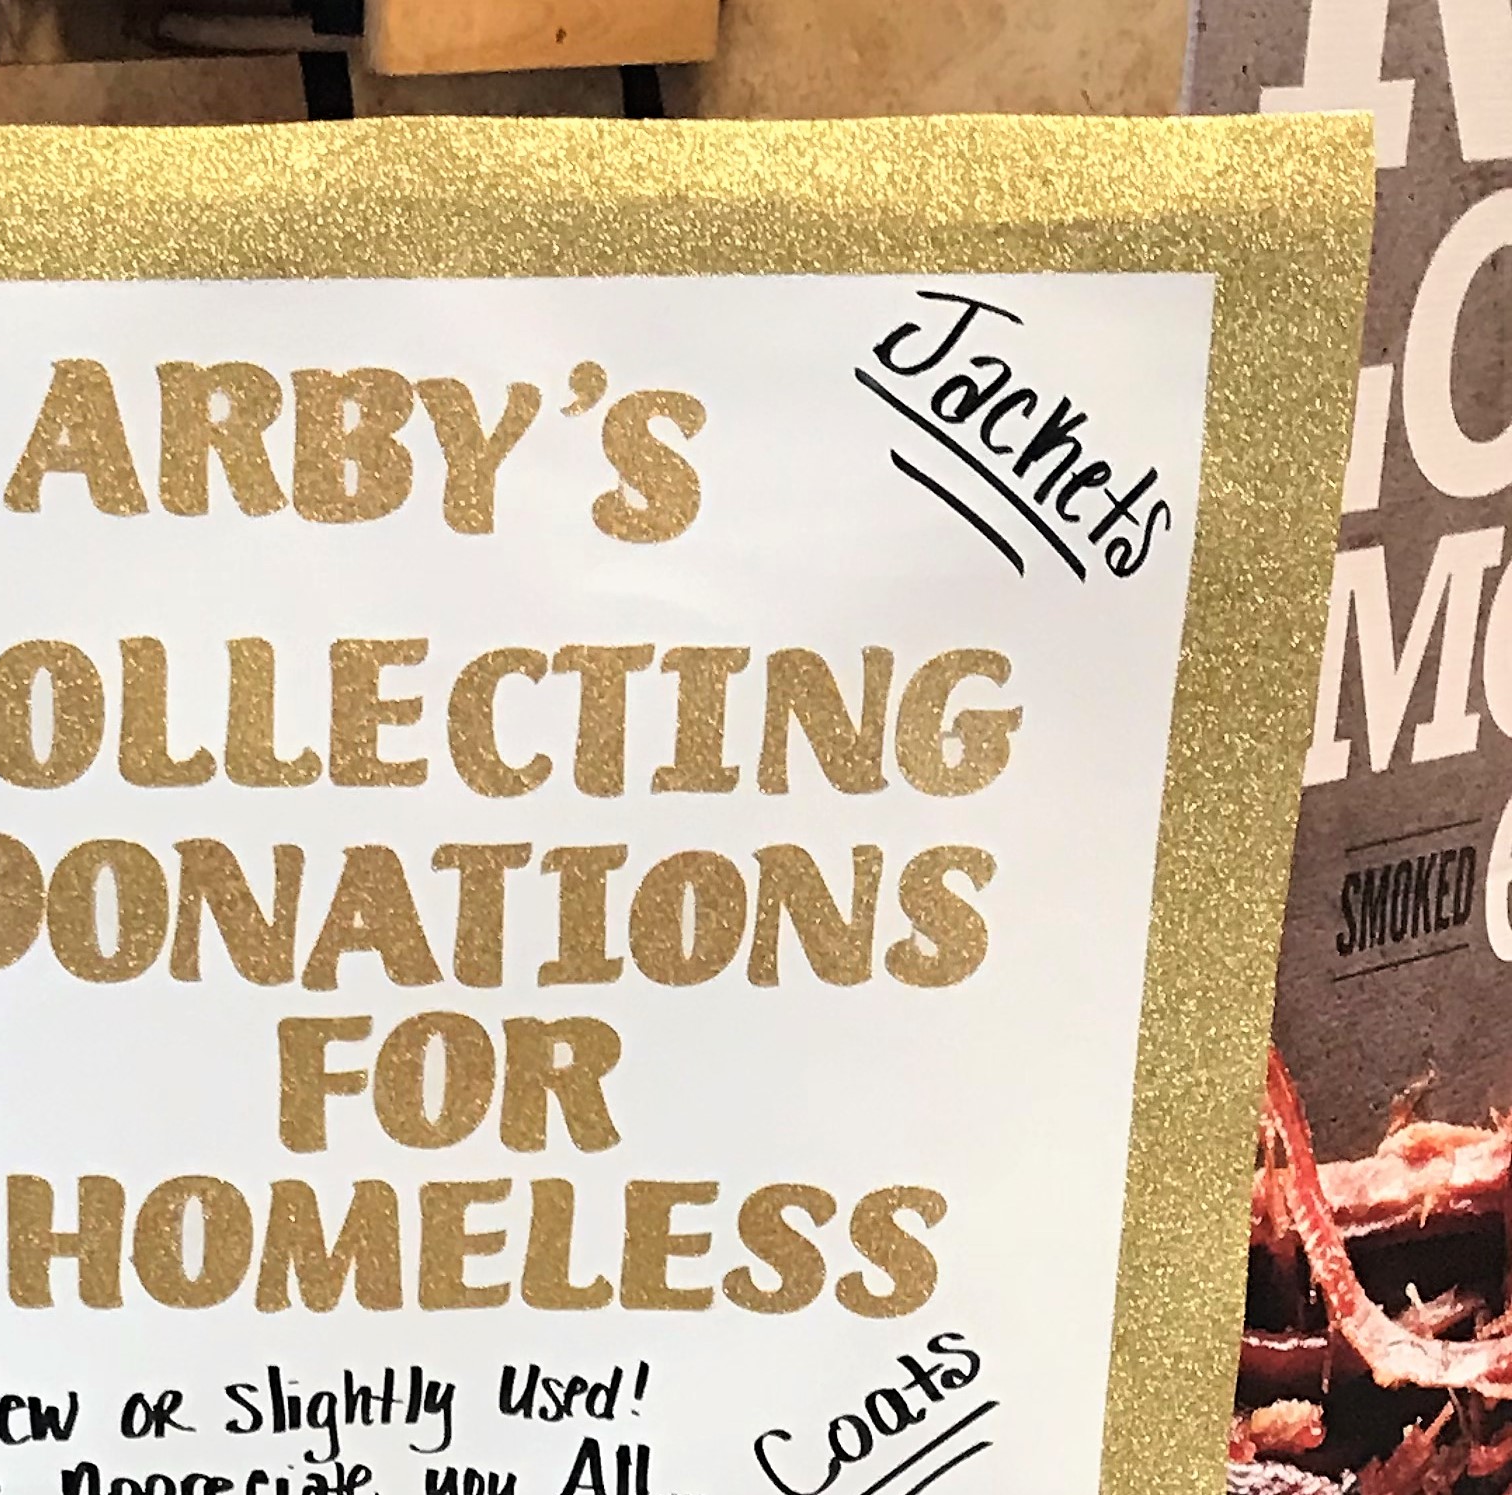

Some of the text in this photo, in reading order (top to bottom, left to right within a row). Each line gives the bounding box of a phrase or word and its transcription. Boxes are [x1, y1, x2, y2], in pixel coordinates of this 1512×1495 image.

[2, 357, 708, 546] ARBY'S
[872, 289, 1173, 578] Jackets
[1336, 846, 1477, 957] SMOKED
[277, 1011, 622, 1155] FOR
[6, 1172, 948, 1320] HOMELESS
